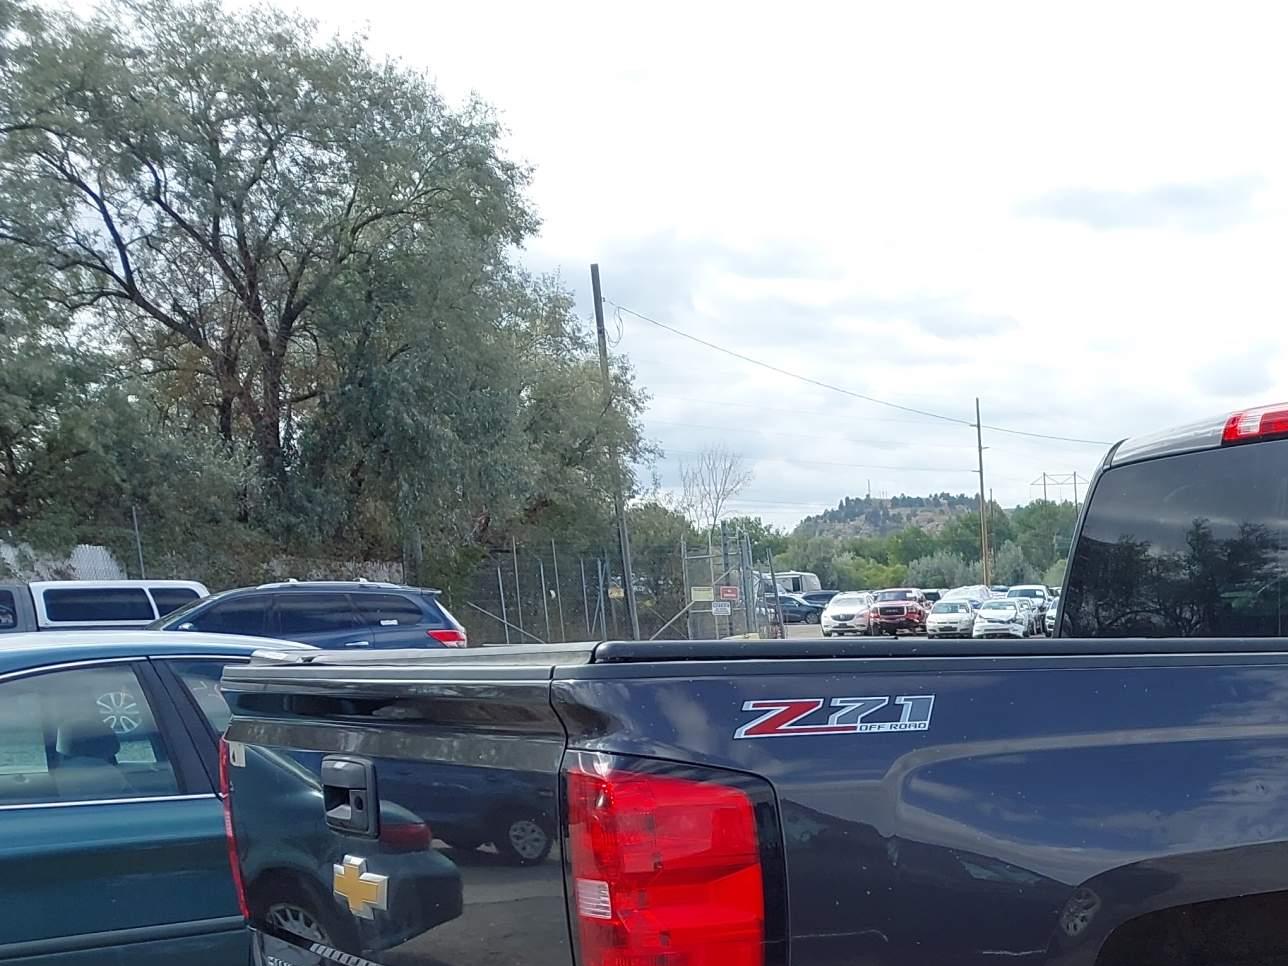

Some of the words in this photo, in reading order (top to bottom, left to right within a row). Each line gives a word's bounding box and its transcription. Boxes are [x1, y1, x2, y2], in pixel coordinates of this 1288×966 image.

[734, 695, 935, 738] Z71
[859, 724, 885, 732] OFF
[889, 722, 927, 731] ROAD
